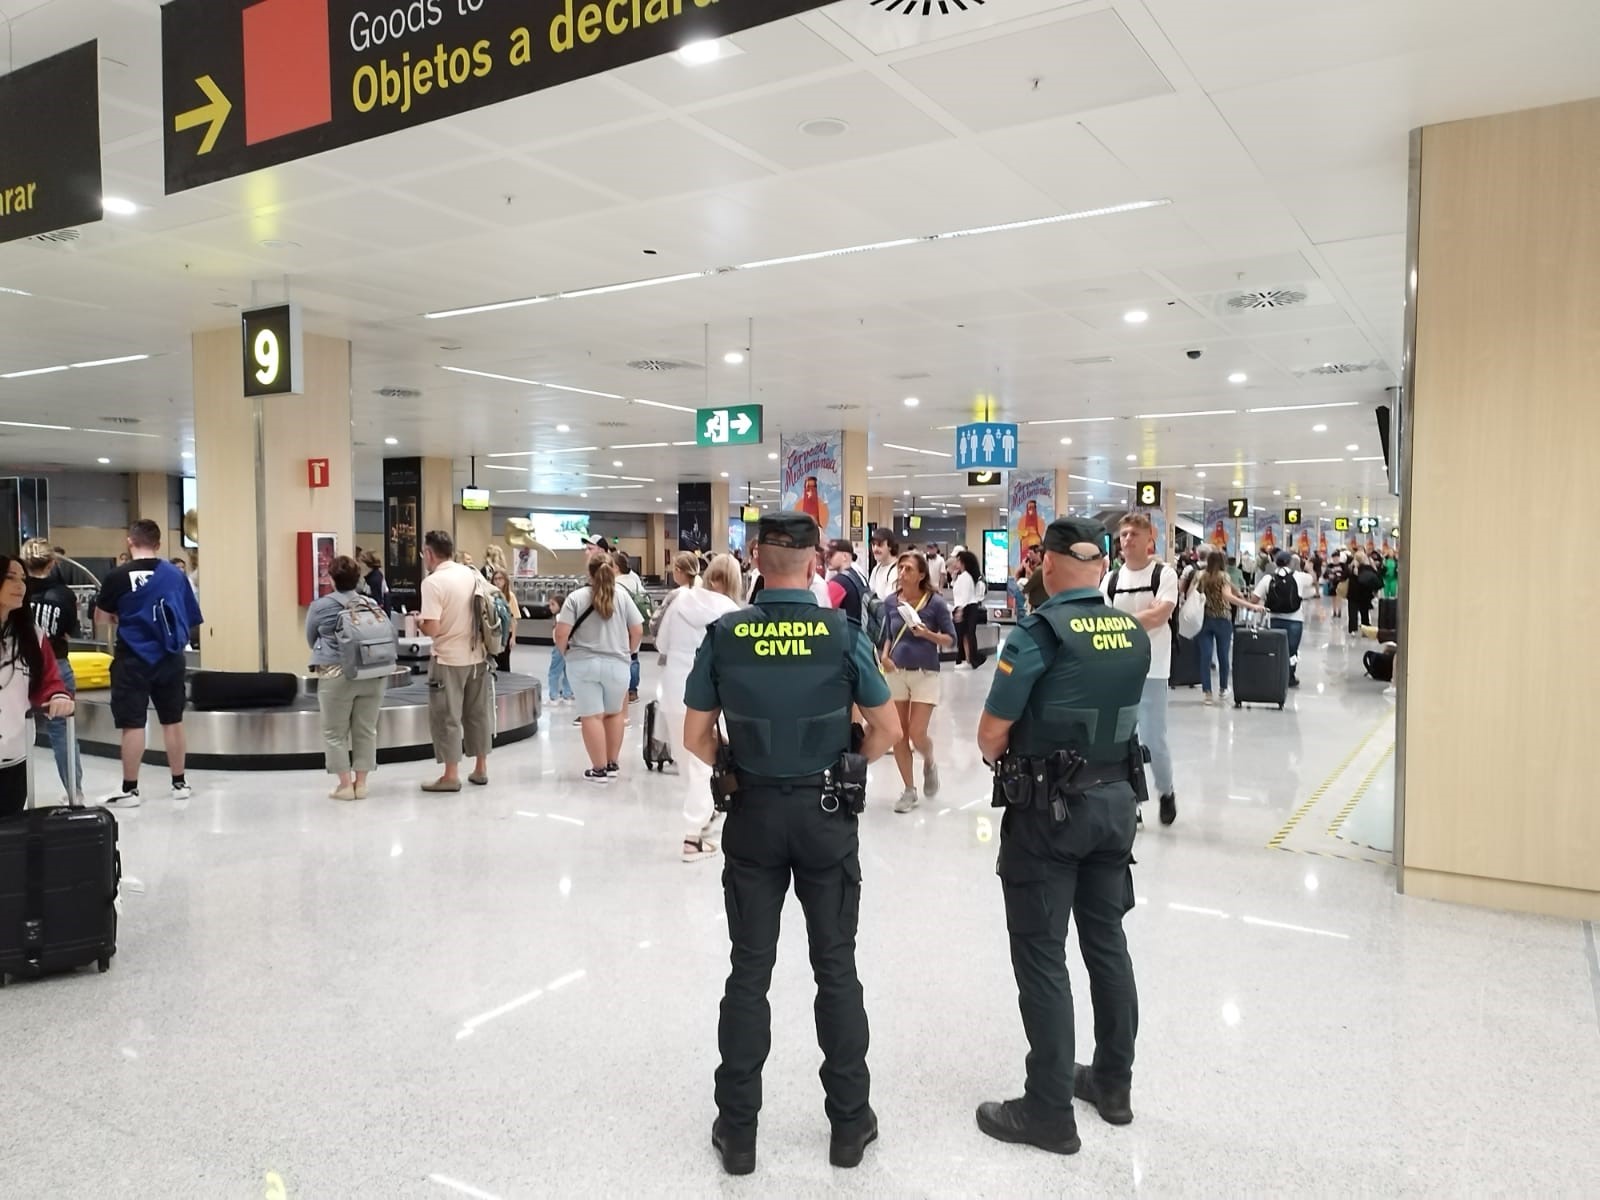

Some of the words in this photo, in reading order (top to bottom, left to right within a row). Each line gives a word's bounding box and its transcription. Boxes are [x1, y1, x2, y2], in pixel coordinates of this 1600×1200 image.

[350, 0, 443, 52] Goods
[352, 39, 492, 113] Objetos
[509, 27, 531, 66] a
[254, 328, 280, 385] 9
[1141, 485, 1155, 504] 8
[1232, 500, 1244, 517] 7
[1288, 510, 1298, 523] 6
[733, 621, 830, 638] GUARDIA
[1069, 616, 1138, 633] GUARDIA
[754, 639, 812, 656] CIVIL
[1092, 632, 1133, 650] CIVIL
